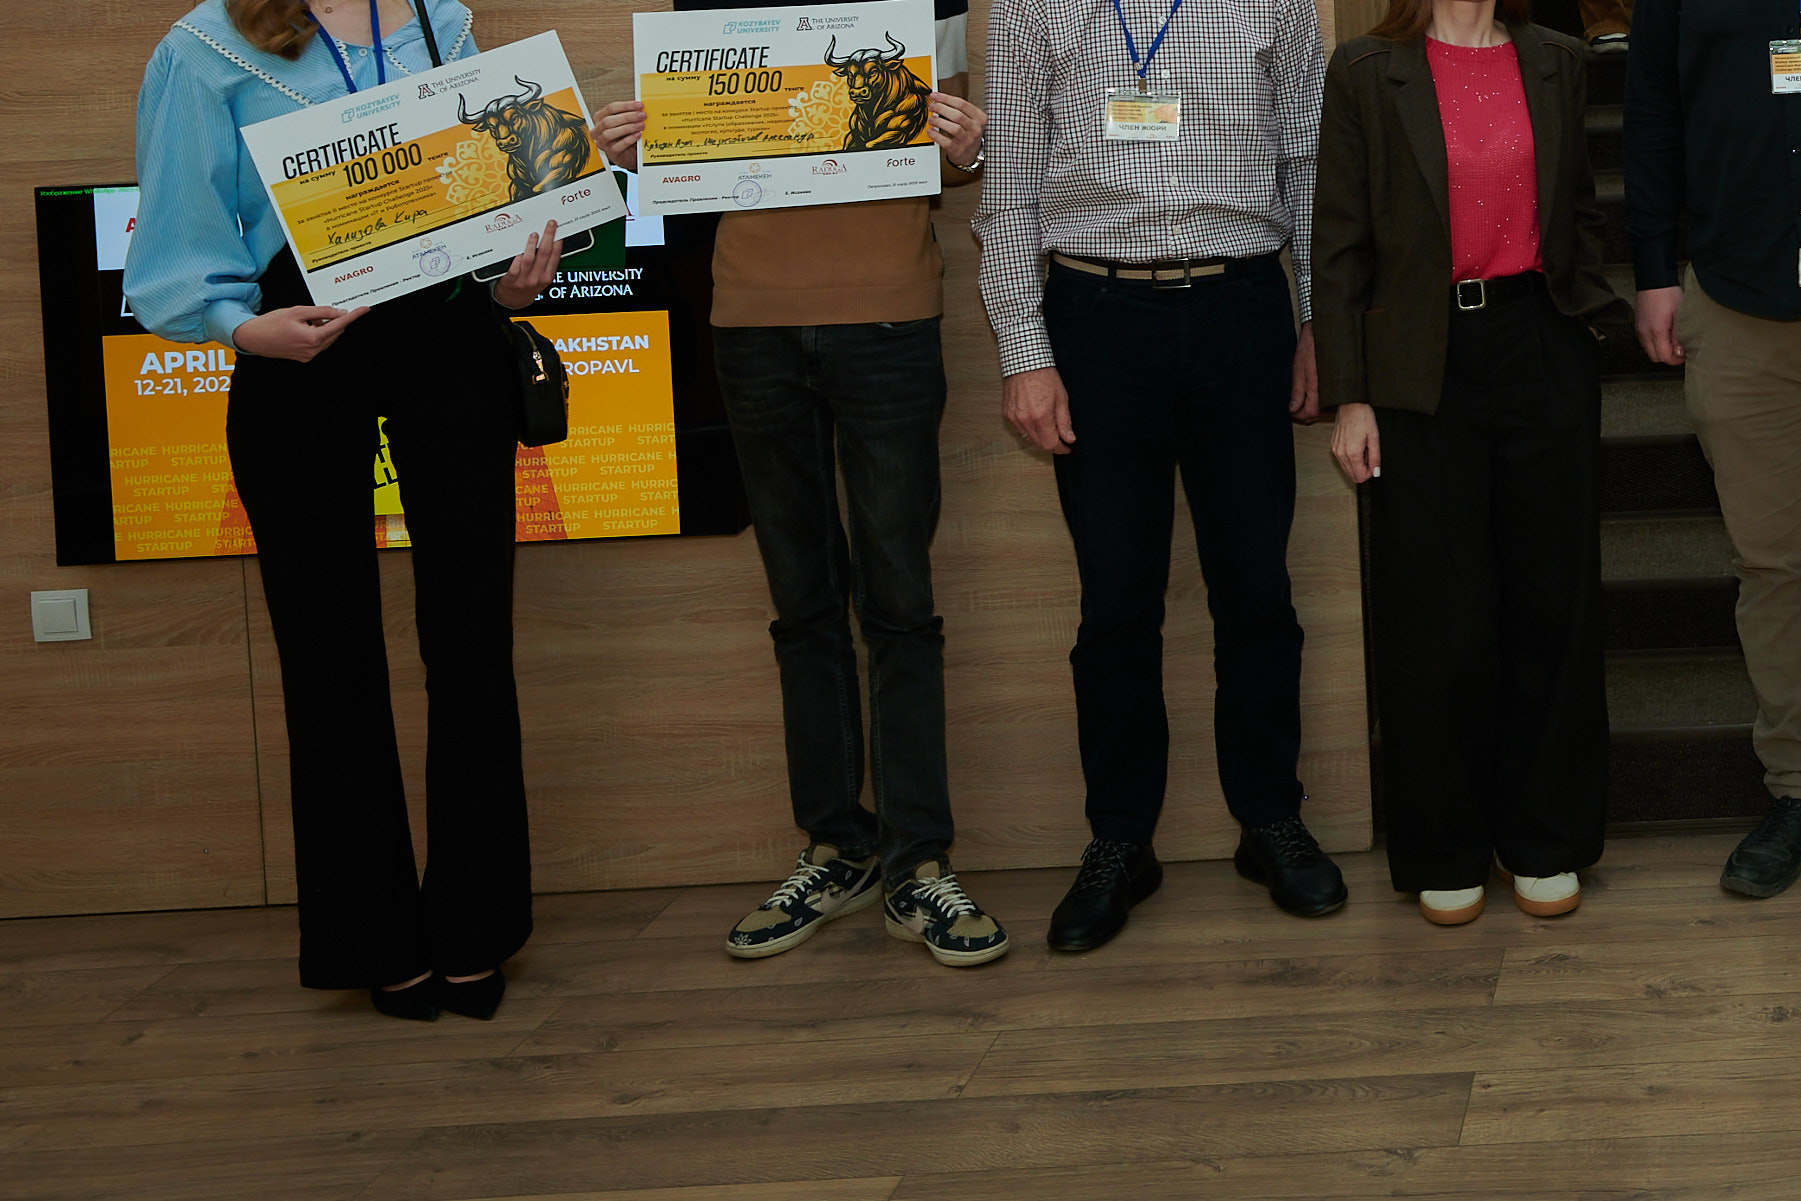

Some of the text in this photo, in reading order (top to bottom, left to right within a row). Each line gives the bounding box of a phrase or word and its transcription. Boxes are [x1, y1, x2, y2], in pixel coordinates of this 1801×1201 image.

[824, 14, 859, 23] UNIVERSITY
[825, 21, 854, 29] ARIZONA
[736, 24, 780, 33] UNIVERSITY
[655, 44, 769, 74] CERTIFICATE
[431, 66, 482, 88] THE UNIVERSITY
[447, 74, 479, 91] ARIZONA
[708, 71, 740, 96] 150
[744, 69, 782, 94] 000
[356, 98, 401, 120] UNIVERSITY
[703, 98, 756, 108] награждается
[281, 121, 402, 182] CERTIFICATE
[344, 155, 379, 188] 100
[381, 141, 423, 176] 000
[885, 156, 916, 167] Forte
[661, 173, 701, 184] AVAGRO
[344, 178, 401, 202] награждается
[559, 187, 593, 206] Forte
[332, 264, 375, 284] AVAGRO
[567, 268, 643, 283] UNIVERSITY
[549, 284, 633, 299] OF ARIZONA
[553, 335, 649, 353] AKHSTAN
[140, 349, 236, 375] APRIL
[562, 359, 640, 376] ROPAVL
[134, 376, 231, 396] 12-21, 202
[515, 455, 586, 468] HURRICANE
[591, 451, 663, 464] HURRICANE
[600, 464, 655, 475] STARTUP
[125, 473, 197, 486] HURRICANE
[554, 480, 626, 492] HURRICANE
[134, 486, 190, 497] STARTUP
[165, 499, 238, 511] HURRICANE
[563, 493, 618, 505] STARTUP
[594, 507, 666, 519] HURRICANE
[603, 519, 658, 530] STARTUP
[128, 529, 201, 542] HURRICANE
[136, 540, 193, 552] STARTUP
